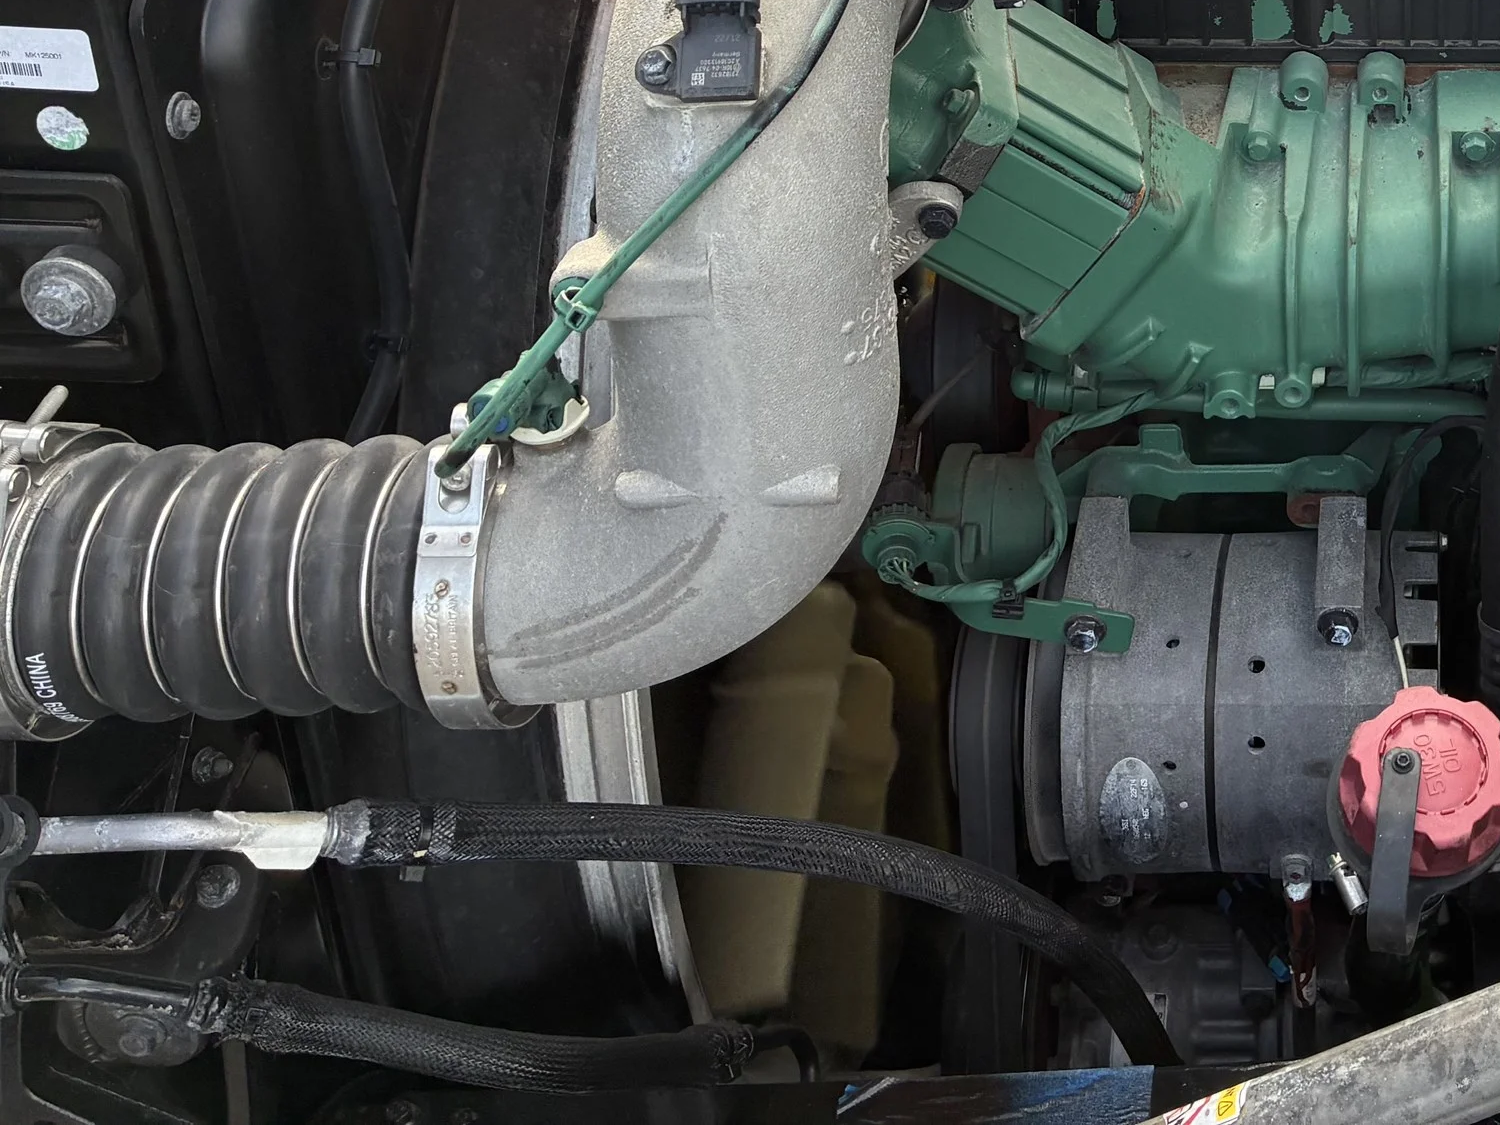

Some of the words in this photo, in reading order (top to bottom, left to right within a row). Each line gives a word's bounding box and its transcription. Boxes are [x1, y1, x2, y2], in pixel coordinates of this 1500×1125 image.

[25, 652, 57, 699] CHINA
[1413, 734, 1446, 797] 5W30
[1446, 738, 1463, 774] OIL
